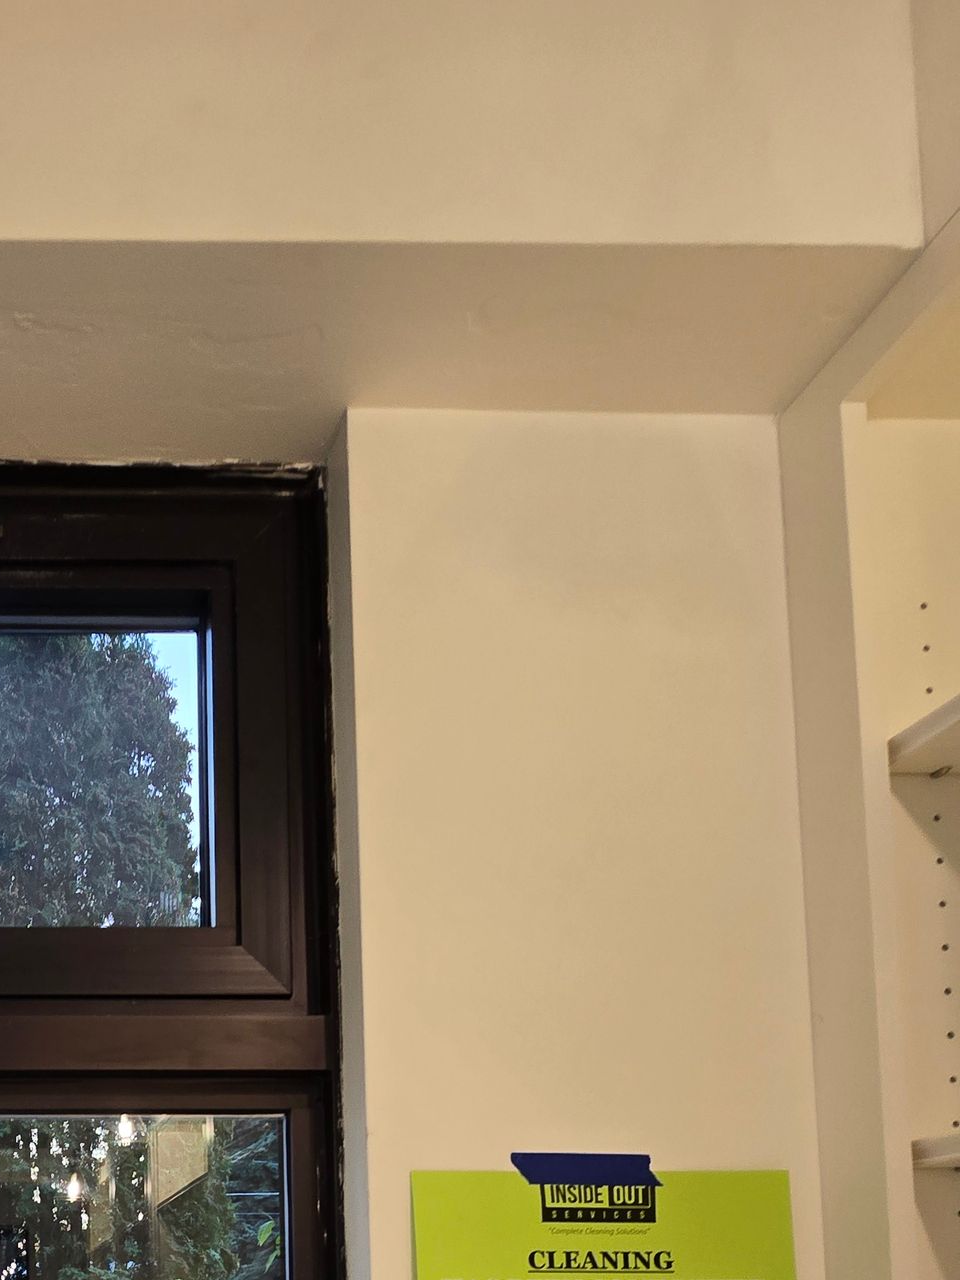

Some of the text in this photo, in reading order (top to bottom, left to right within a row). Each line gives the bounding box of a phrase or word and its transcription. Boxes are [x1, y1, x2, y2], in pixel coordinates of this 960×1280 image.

[550, 1185, 646, 1205] INSIDE OUT
[551, 1210, 646, 1219] SERVICES
[528, 1250, 675, 1270] CLEANING
